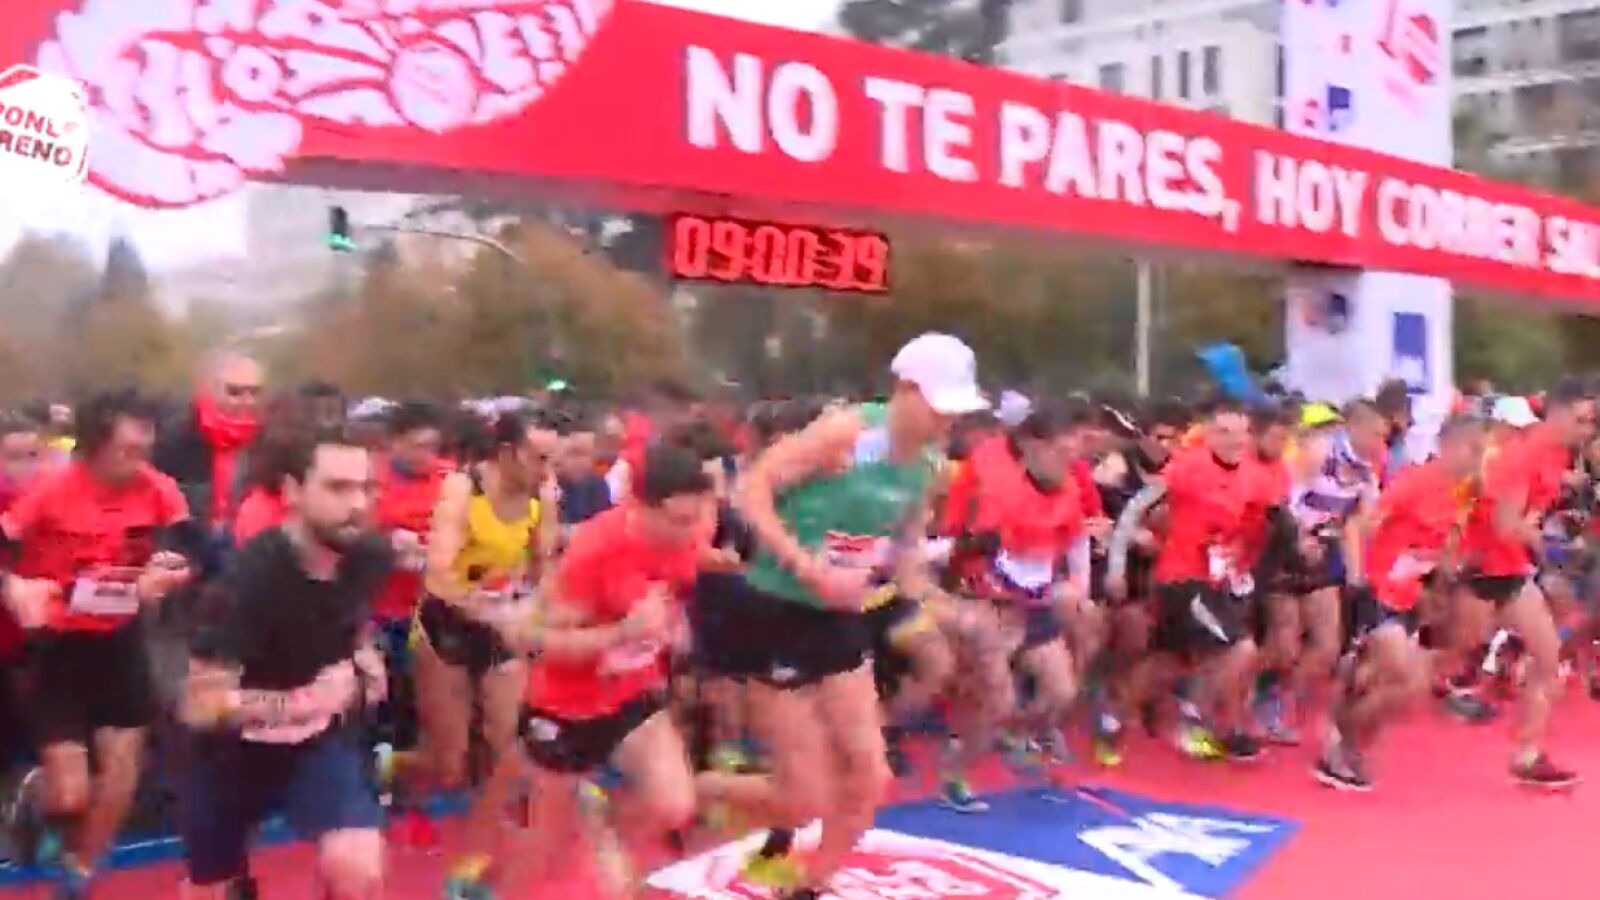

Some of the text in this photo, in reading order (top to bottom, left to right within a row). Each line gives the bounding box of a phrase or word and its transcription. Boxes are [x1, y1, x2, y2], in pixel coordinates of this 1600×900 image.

[685, 45, 839, 162] NO
[864, 76, 978, 182] TE
[998, 100, 1242, 232] PARES,
[1254, 150, 1369, 238] HOY
